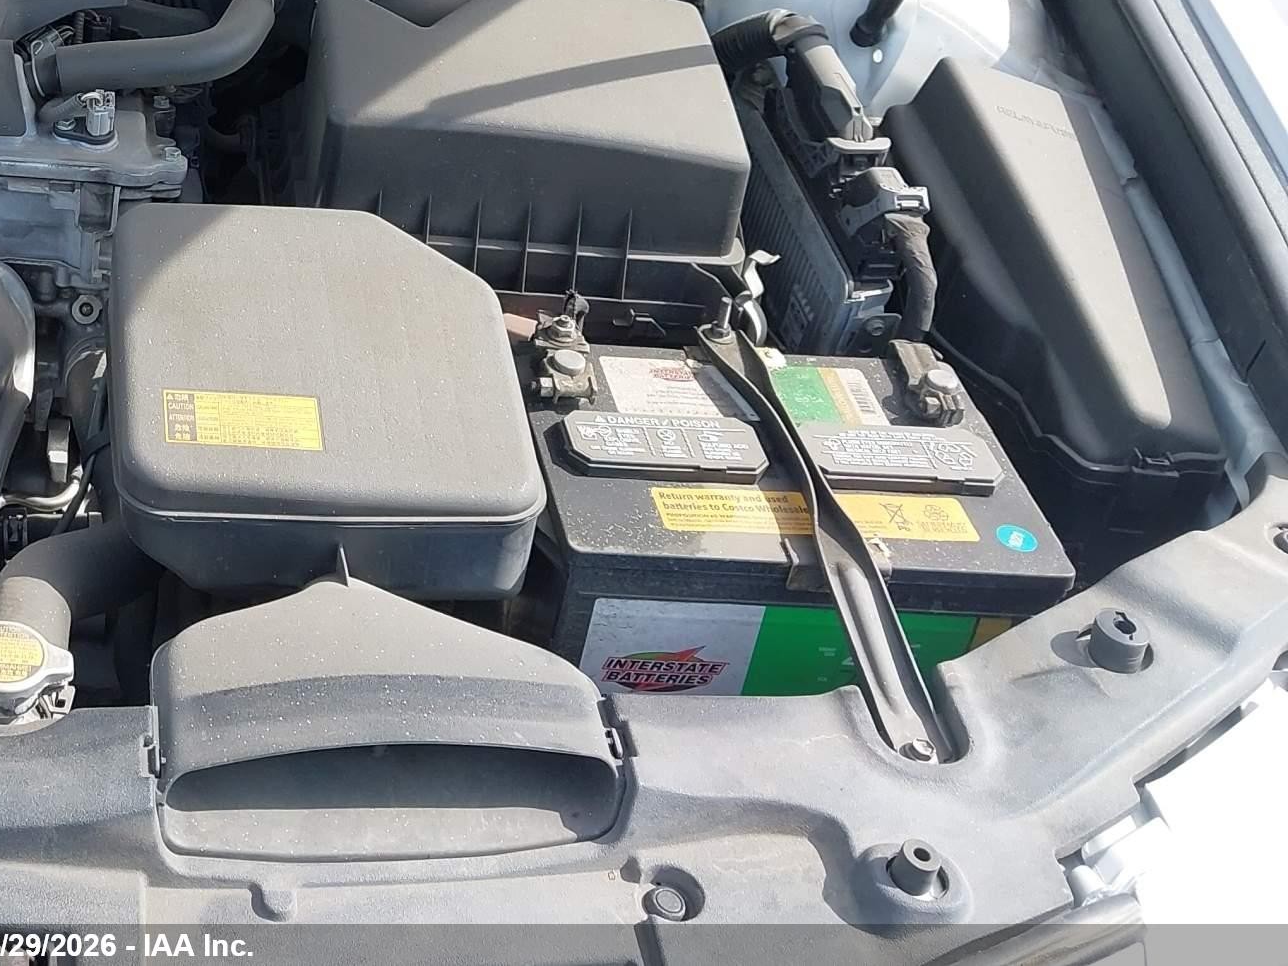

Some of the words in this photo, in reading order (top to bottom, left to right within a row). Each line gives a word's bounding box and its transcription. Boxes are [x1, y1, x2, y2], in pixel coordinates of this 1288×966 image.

[168, 402, 194, 411] CAUTION
[607, 415, 659, 426] DANGER
[671, 418, 720, 428] POISON
[658, 491, 693, 501] Return
[694, 493, 740, 503] warranty
[743, 494, 762, 503] and
[765, 495, 789, 503] used
[663, 501, 708, 512] batteries
[709, 503, 720, 511] to
[723, 503, 755, 512] Costco
[757, 504, 809, 514] Wholesale
[606, 658, 723, 674] INTERSTATE
[606, 670, 710, 685] BATTERIES
